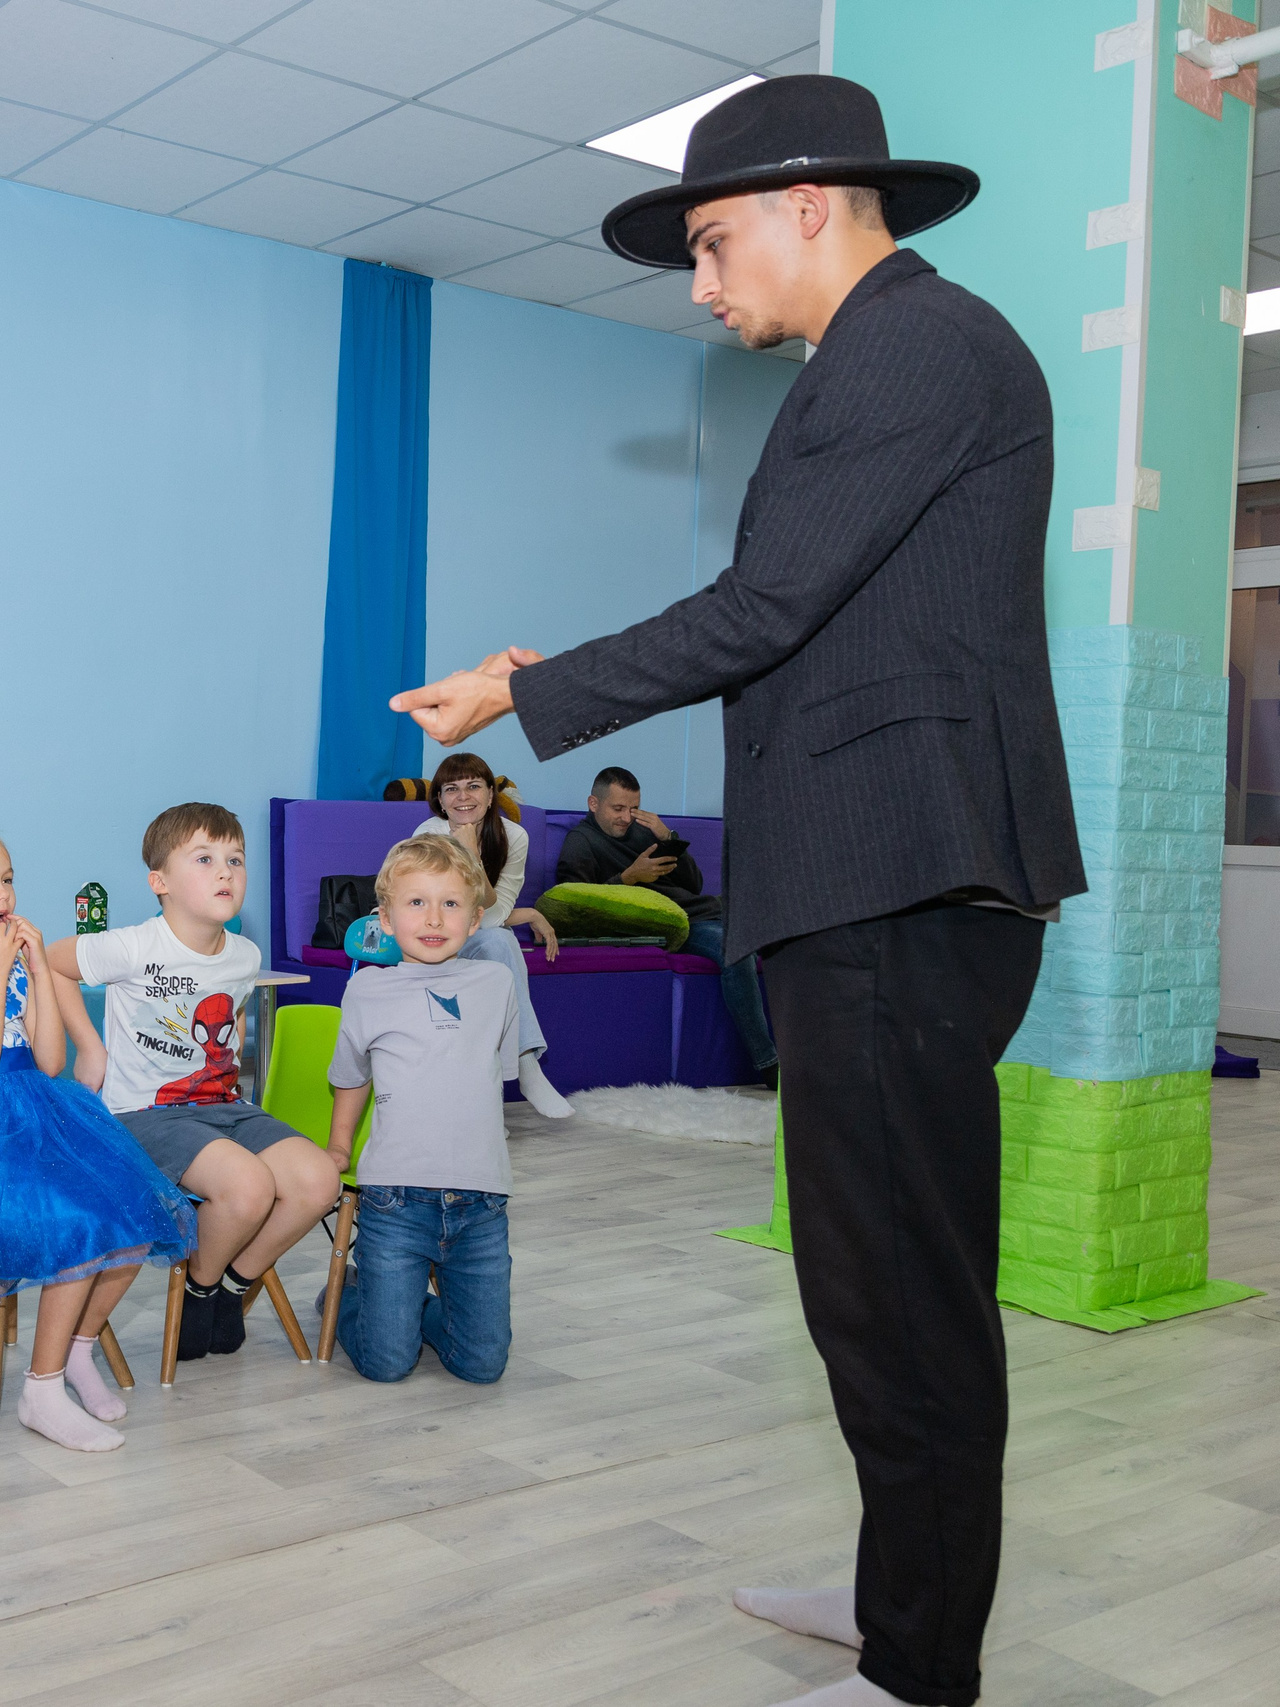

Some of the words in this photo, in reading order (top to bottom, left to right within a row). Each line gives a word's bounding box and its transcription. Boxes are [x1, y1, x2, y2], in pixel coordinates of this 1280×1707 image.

[144, 963, 165, 976] MY
[153, 975, 199, 990] SPIDER-
[136, 1031, 195, 1061] TINGLING!
